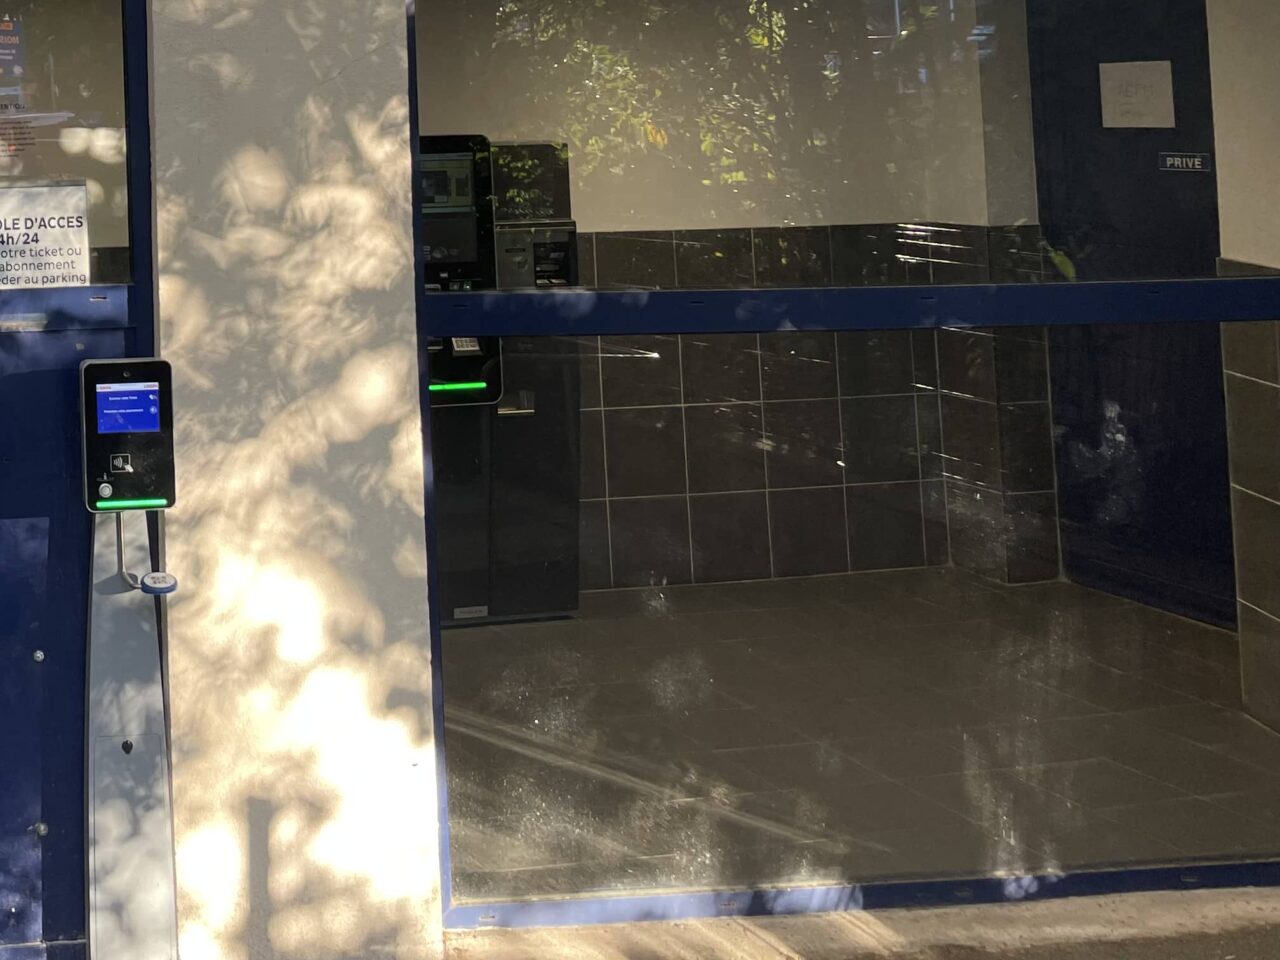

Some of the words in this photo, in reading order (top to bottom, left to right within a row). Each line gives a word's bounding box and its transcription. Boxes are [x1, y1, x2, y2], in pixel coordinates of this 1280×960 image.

[24, 216, 84, 230] D'ACCES
[29, 247, 64, 258] ticket
[67, 247, 82, 257] ou
[24, 275, 38, 285] au
[41, 273, 87, 286] parking
